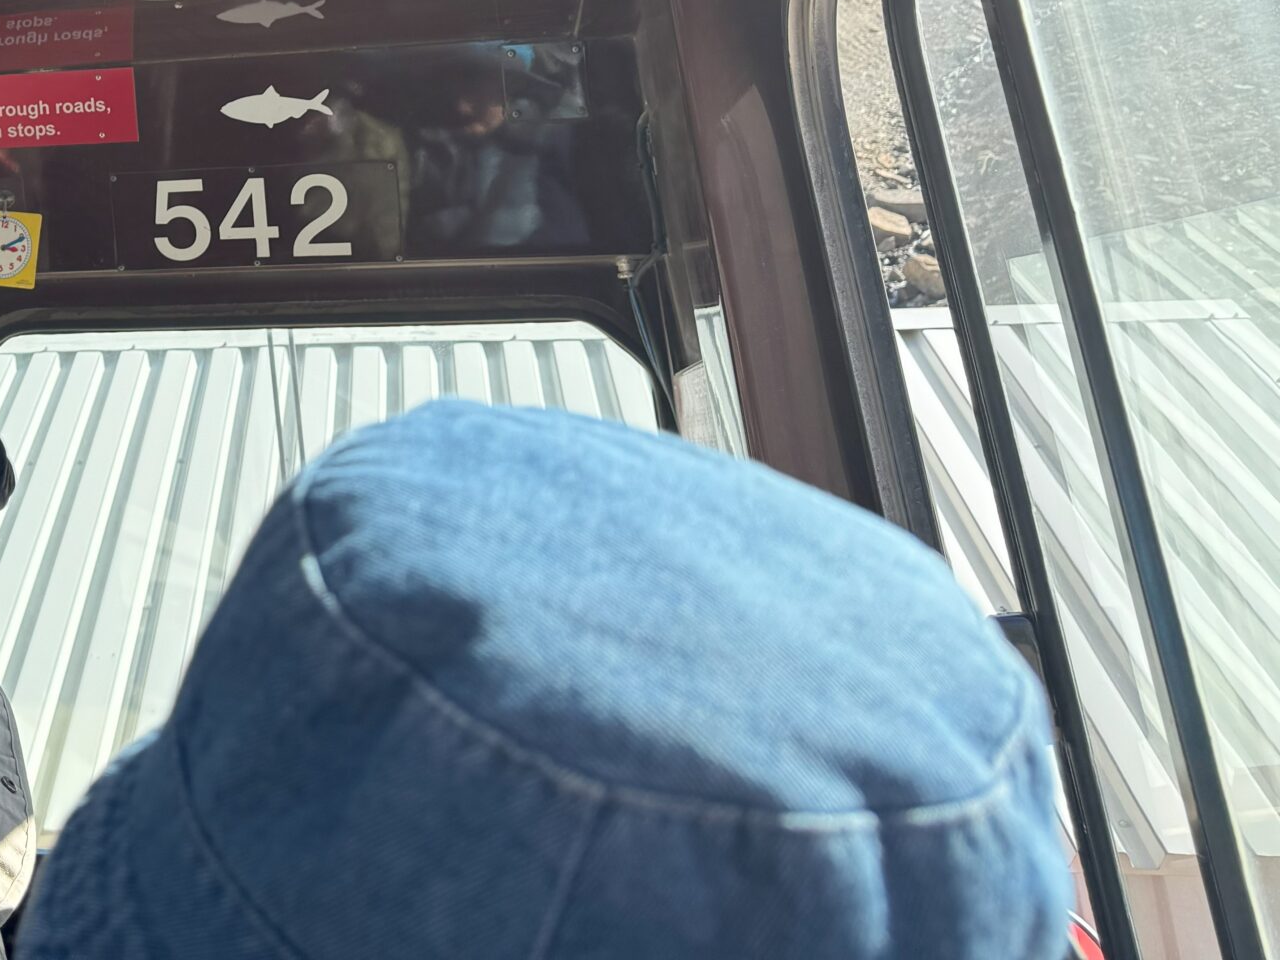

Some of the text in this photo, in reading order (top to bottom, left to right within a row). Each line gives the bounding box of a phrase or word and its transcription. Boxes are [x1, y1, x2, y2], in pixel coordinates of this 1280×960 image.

[55, 97, 111, 115] roads,
[7, 122, 61, 140] stops.
[154, 173, 352, 261] 542
[1, 220, 9, 229] 12
[20, 244, 26, 253] 3
[8, 262, 15, 270] 5
